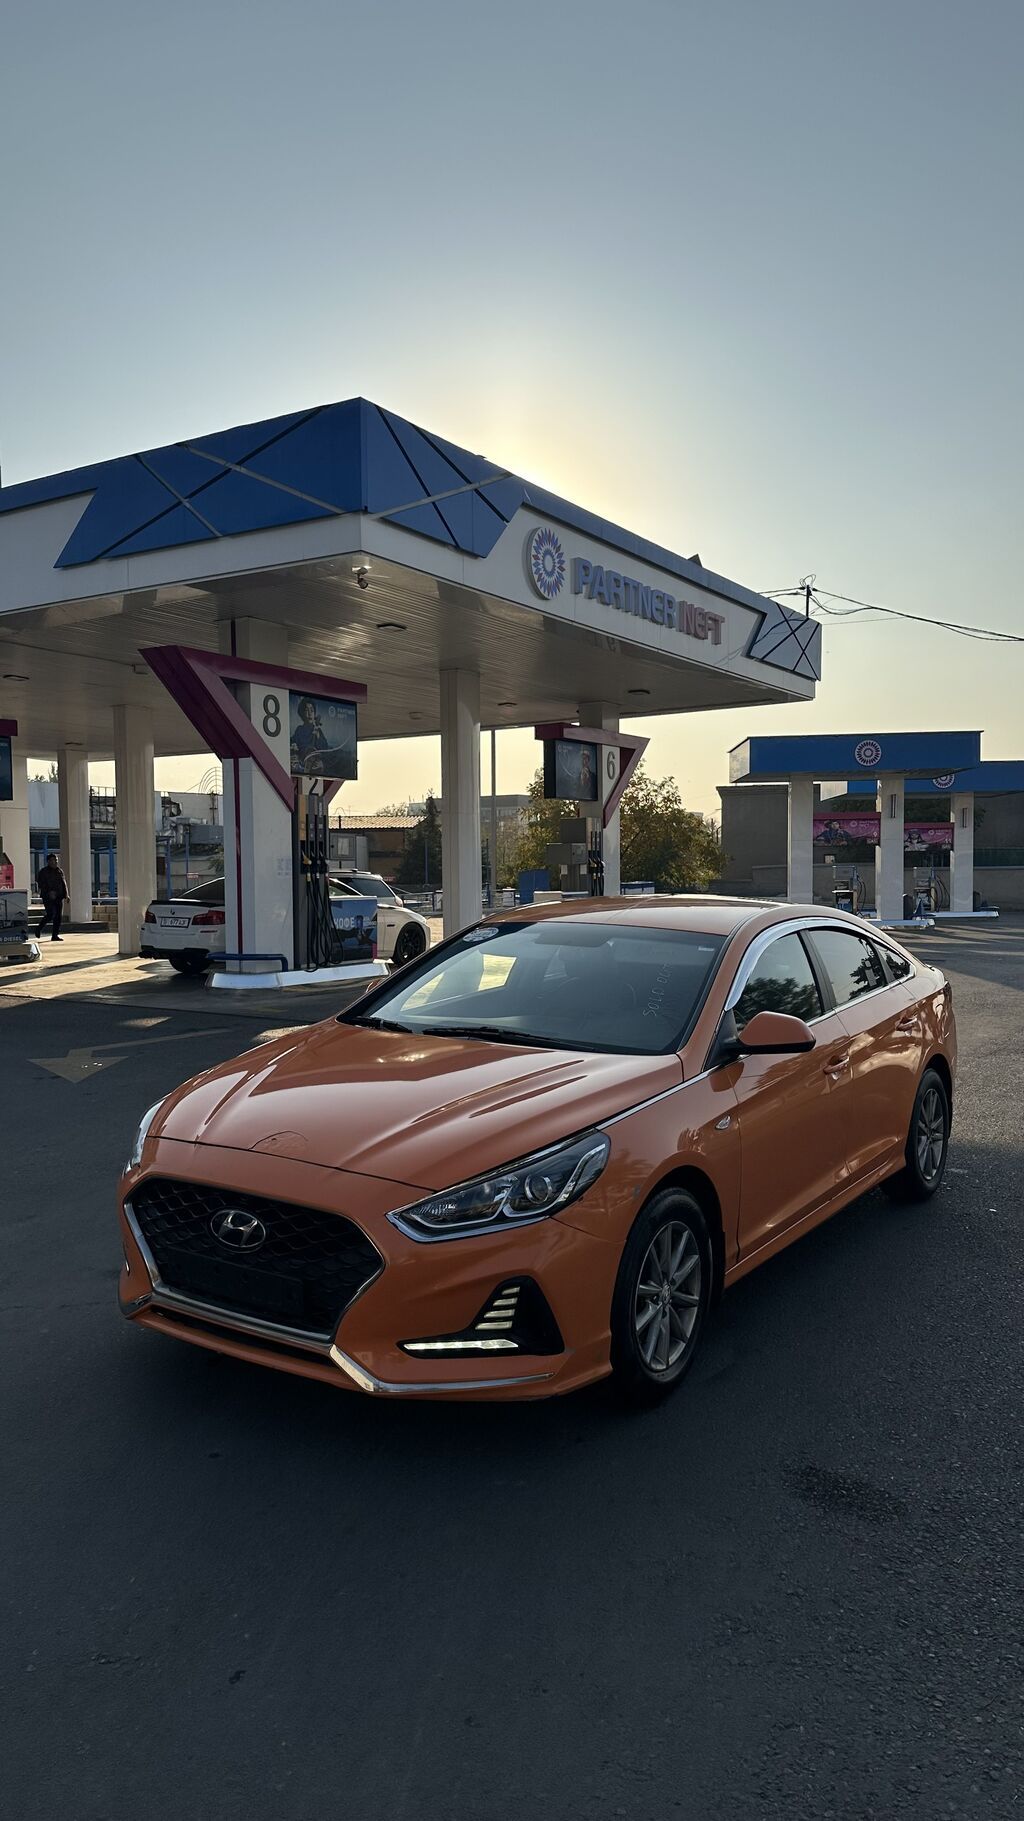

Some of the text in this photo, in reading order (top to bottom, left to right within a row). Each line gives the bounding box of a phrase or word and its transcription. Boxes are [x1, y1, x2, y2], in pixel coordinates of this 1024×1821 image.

[571, 557, 725, 645] PARTNER NEFT
[262, 693, 282, 738] 8
[606, 750, 616, 780] 6
